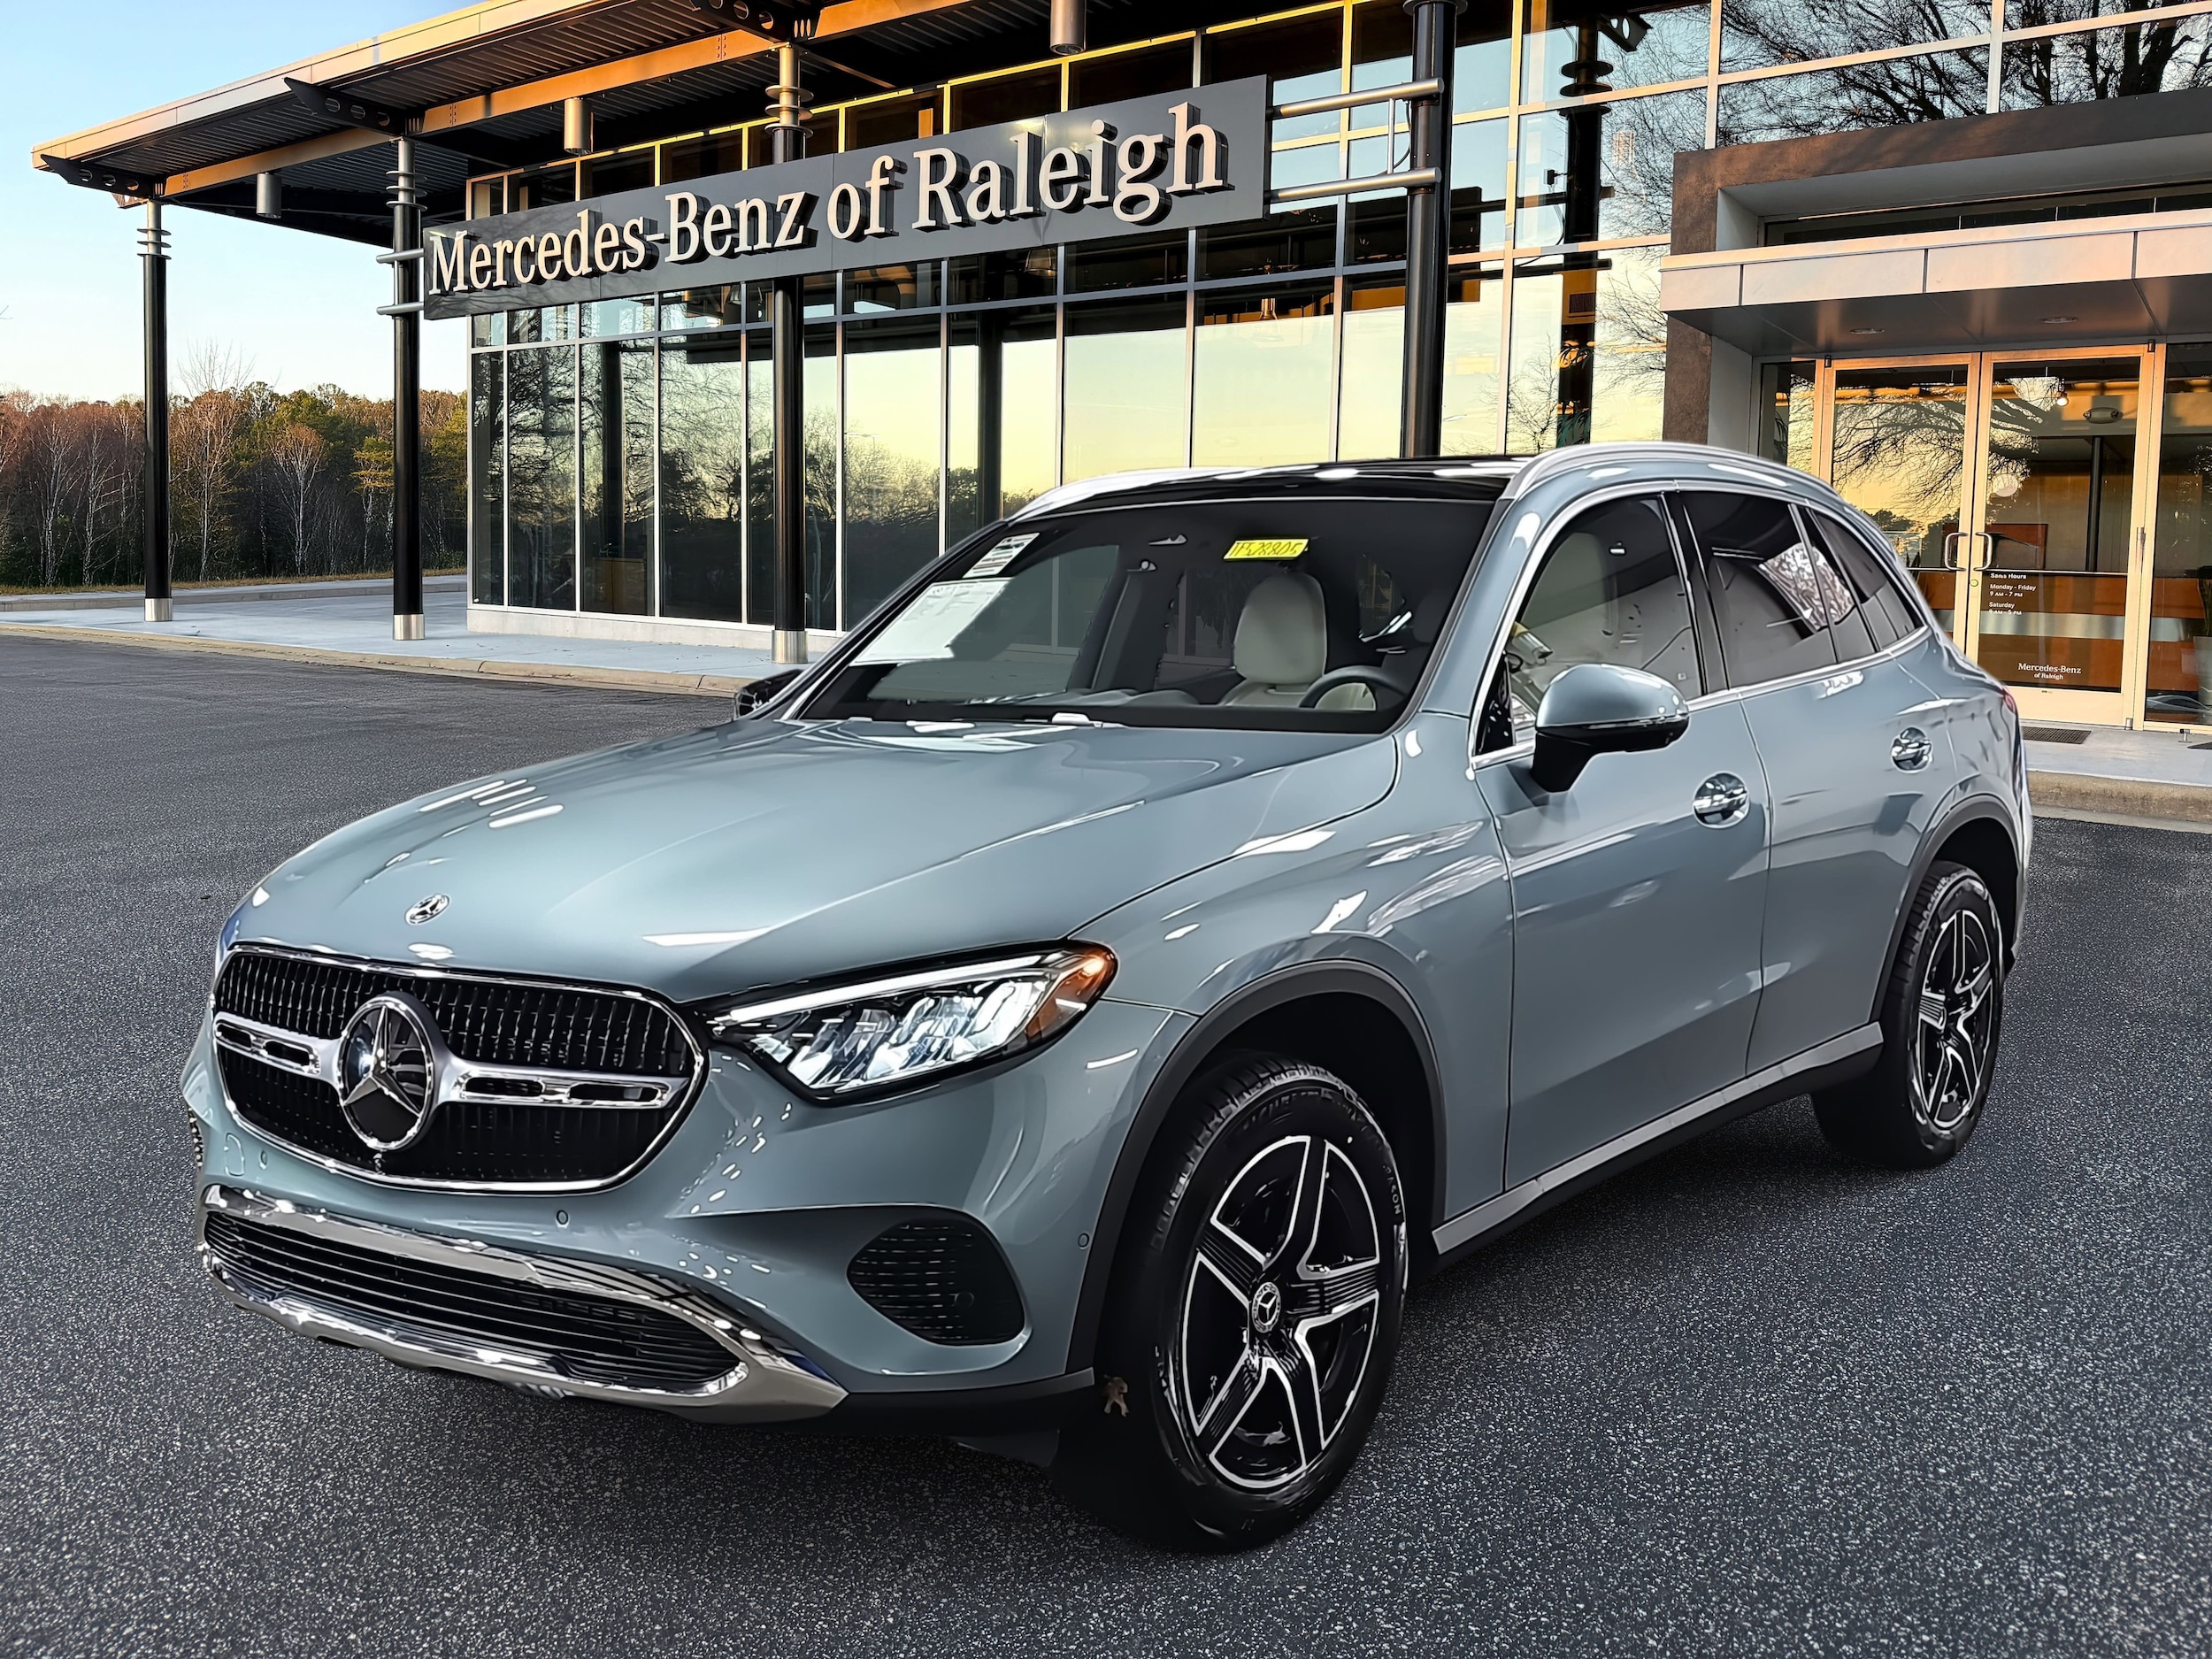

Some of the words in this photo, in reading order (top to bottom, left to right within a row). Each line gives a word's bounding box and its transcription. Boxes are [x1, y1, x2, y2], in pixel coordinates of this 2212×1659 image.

[428, 190, 809, 296] Mercedes-Benz
[827, 155, 901, 240] of
[911, 101, 1228, 223] Raleigh
[2018, 663, 2081, 674] Mercedes-Benz
